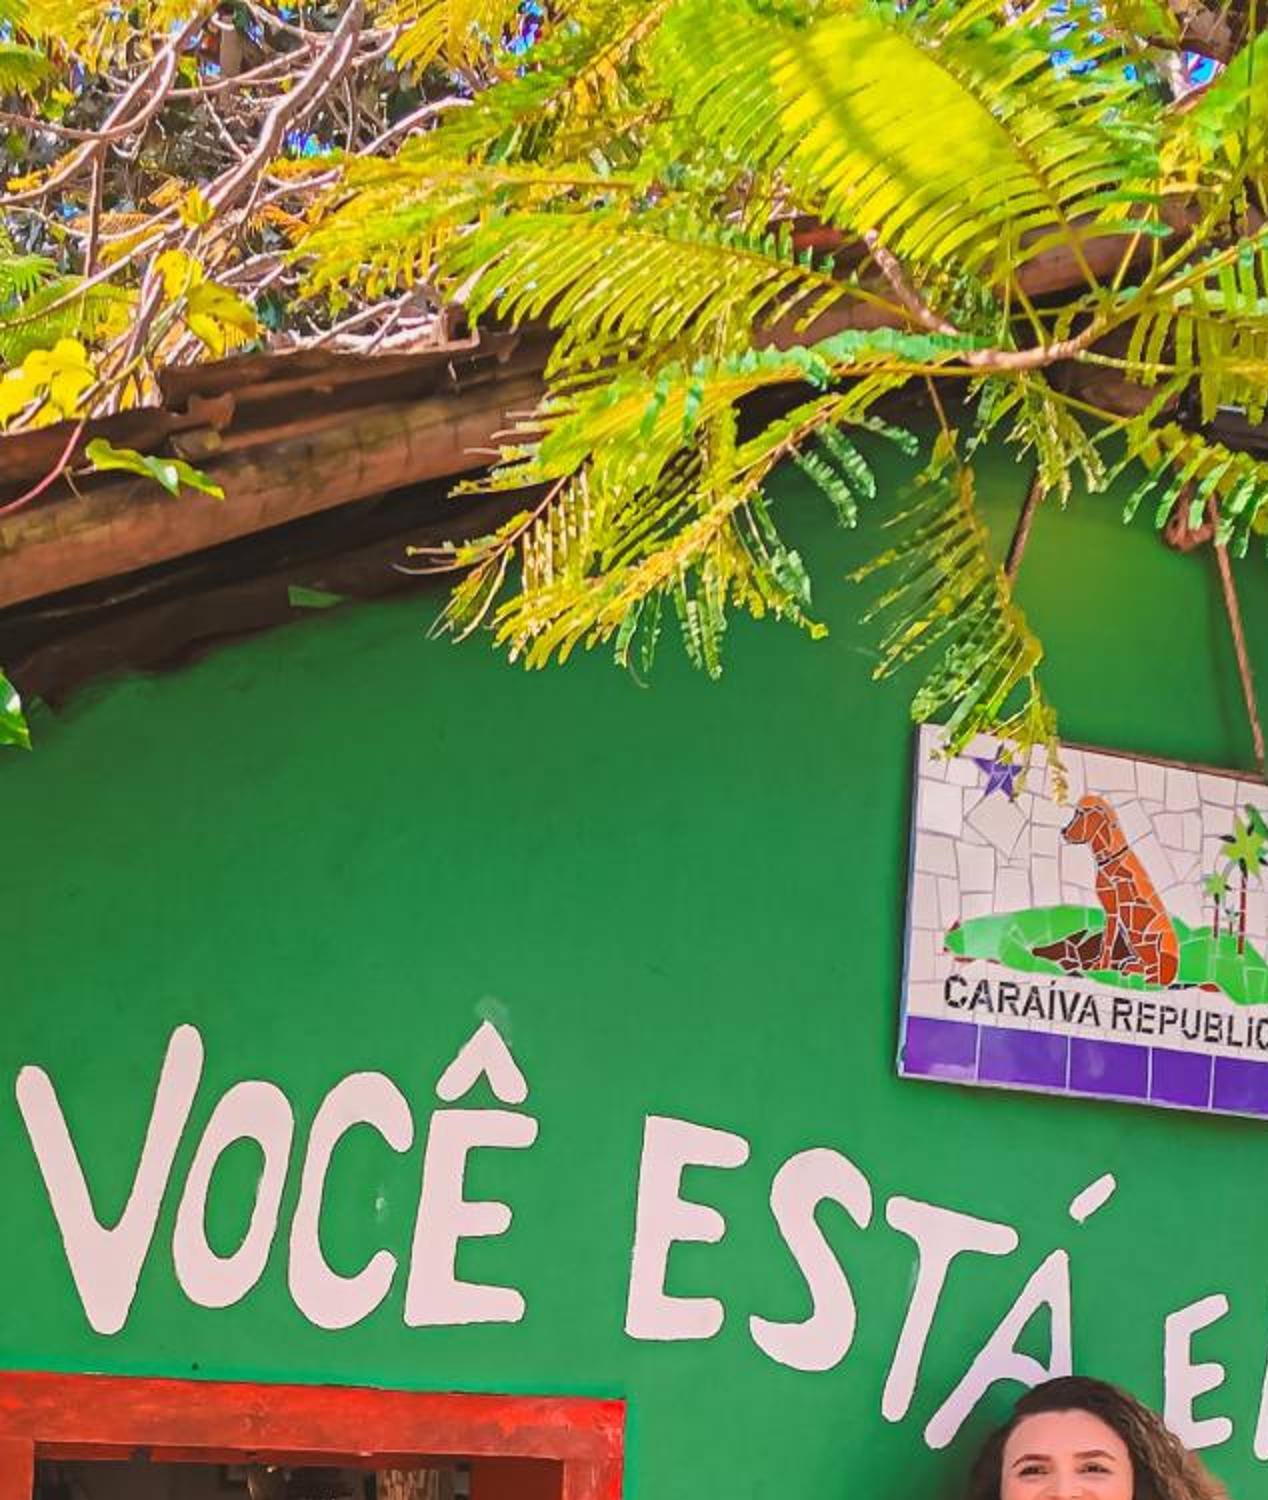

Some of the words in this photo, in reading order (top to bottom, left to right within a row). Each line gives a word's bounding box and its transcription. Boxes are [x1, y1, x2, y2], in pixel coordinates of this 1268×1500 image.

[943, 974, 1101, 1027] CARAÍVA
[15, 1020, 539, 1336] VOCÊ
[624, 1113, 1118, 1449] ESTÁ
